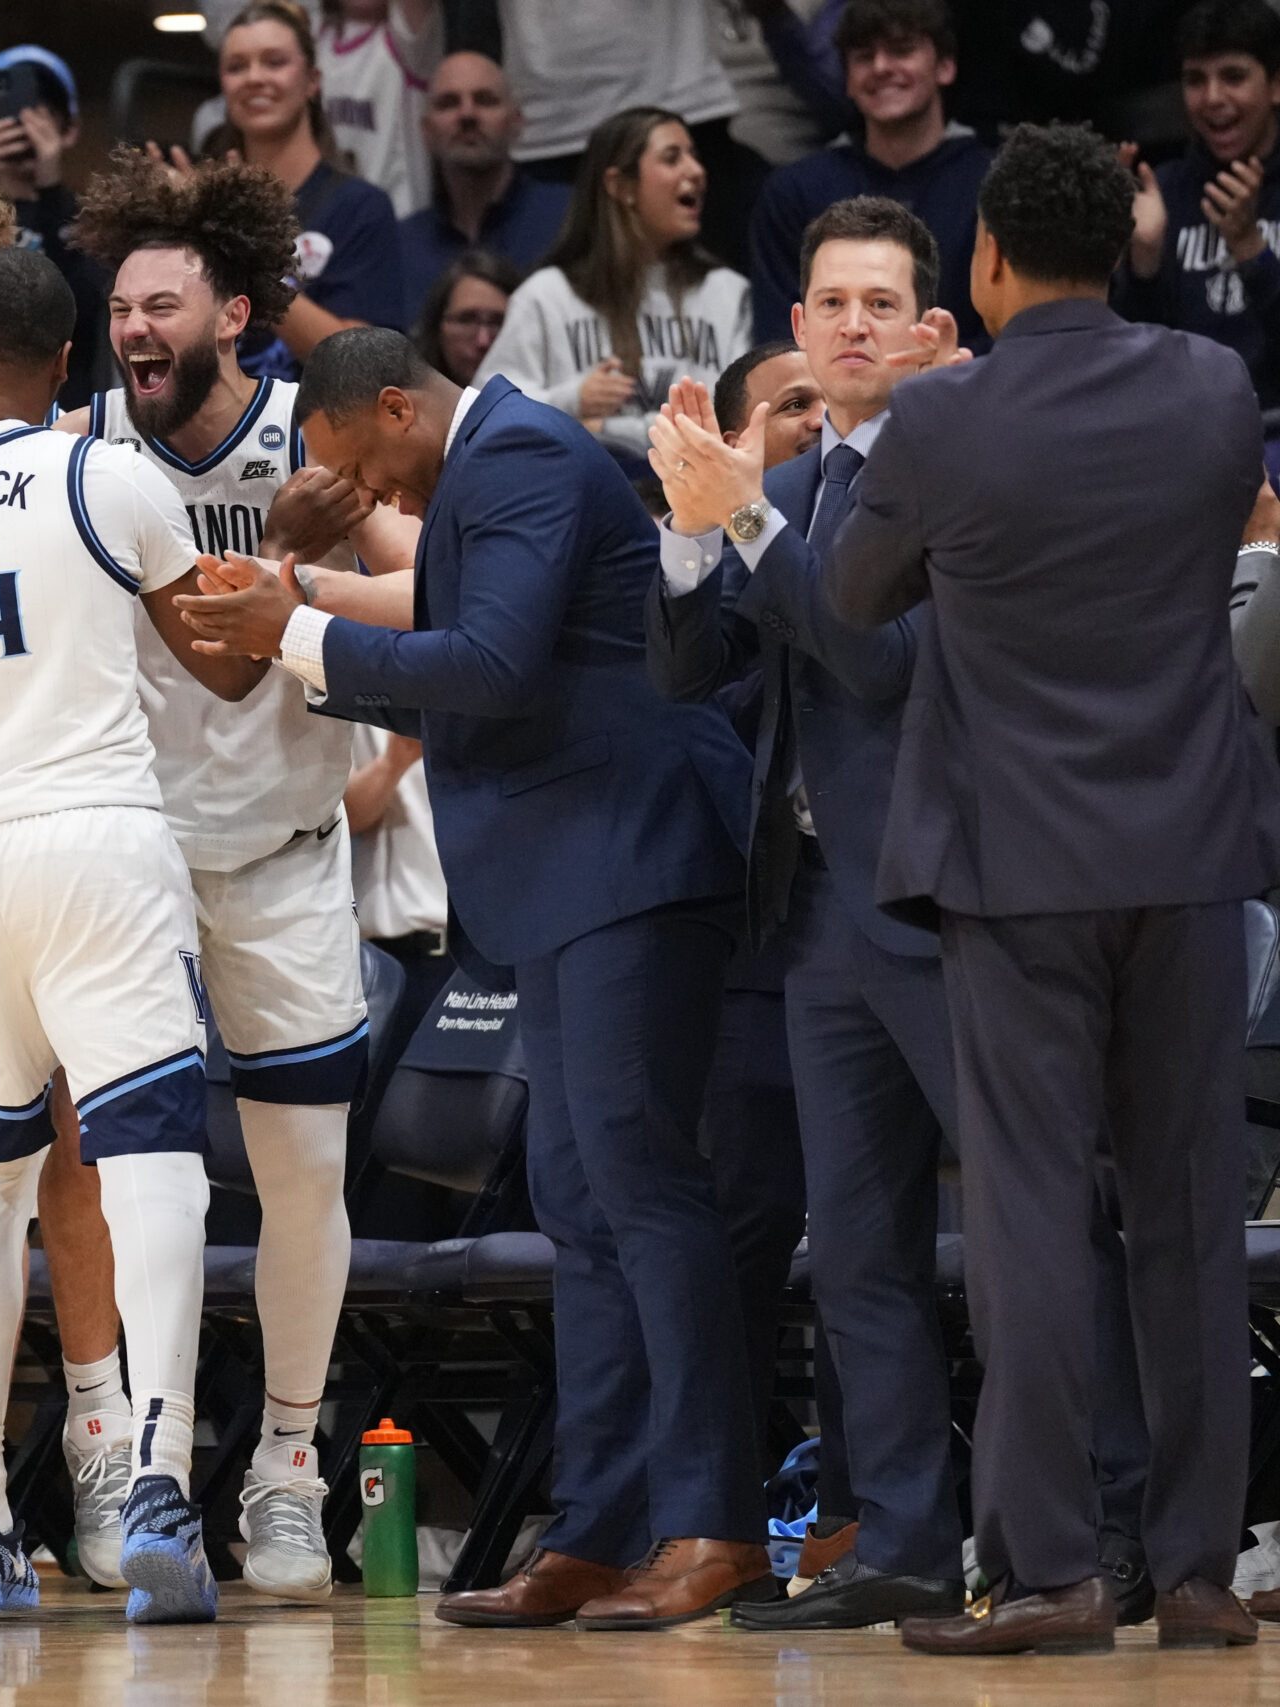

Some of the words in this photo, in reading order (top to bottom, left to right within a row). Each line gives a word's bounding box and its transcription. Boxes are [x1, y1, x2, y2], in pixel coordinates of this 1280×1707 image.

[565, 313, 721, 373] VILNOVA
[263, 432, 280, 443] GHR
[241, 467, 278, 477] EAST
[245, 460, 271, 469] BIG
[443, 991, 469, 1008] Main
[466, 992, 489, 1010] Line
[486, 992, 518, 1010] Health
[436, 1015, 456, 1031] Bryn
[454, 1017, 476, 1030] Mawr
[473, 1017, 506, 1032] Hospital
[360, 1467, 385, 1507] G
